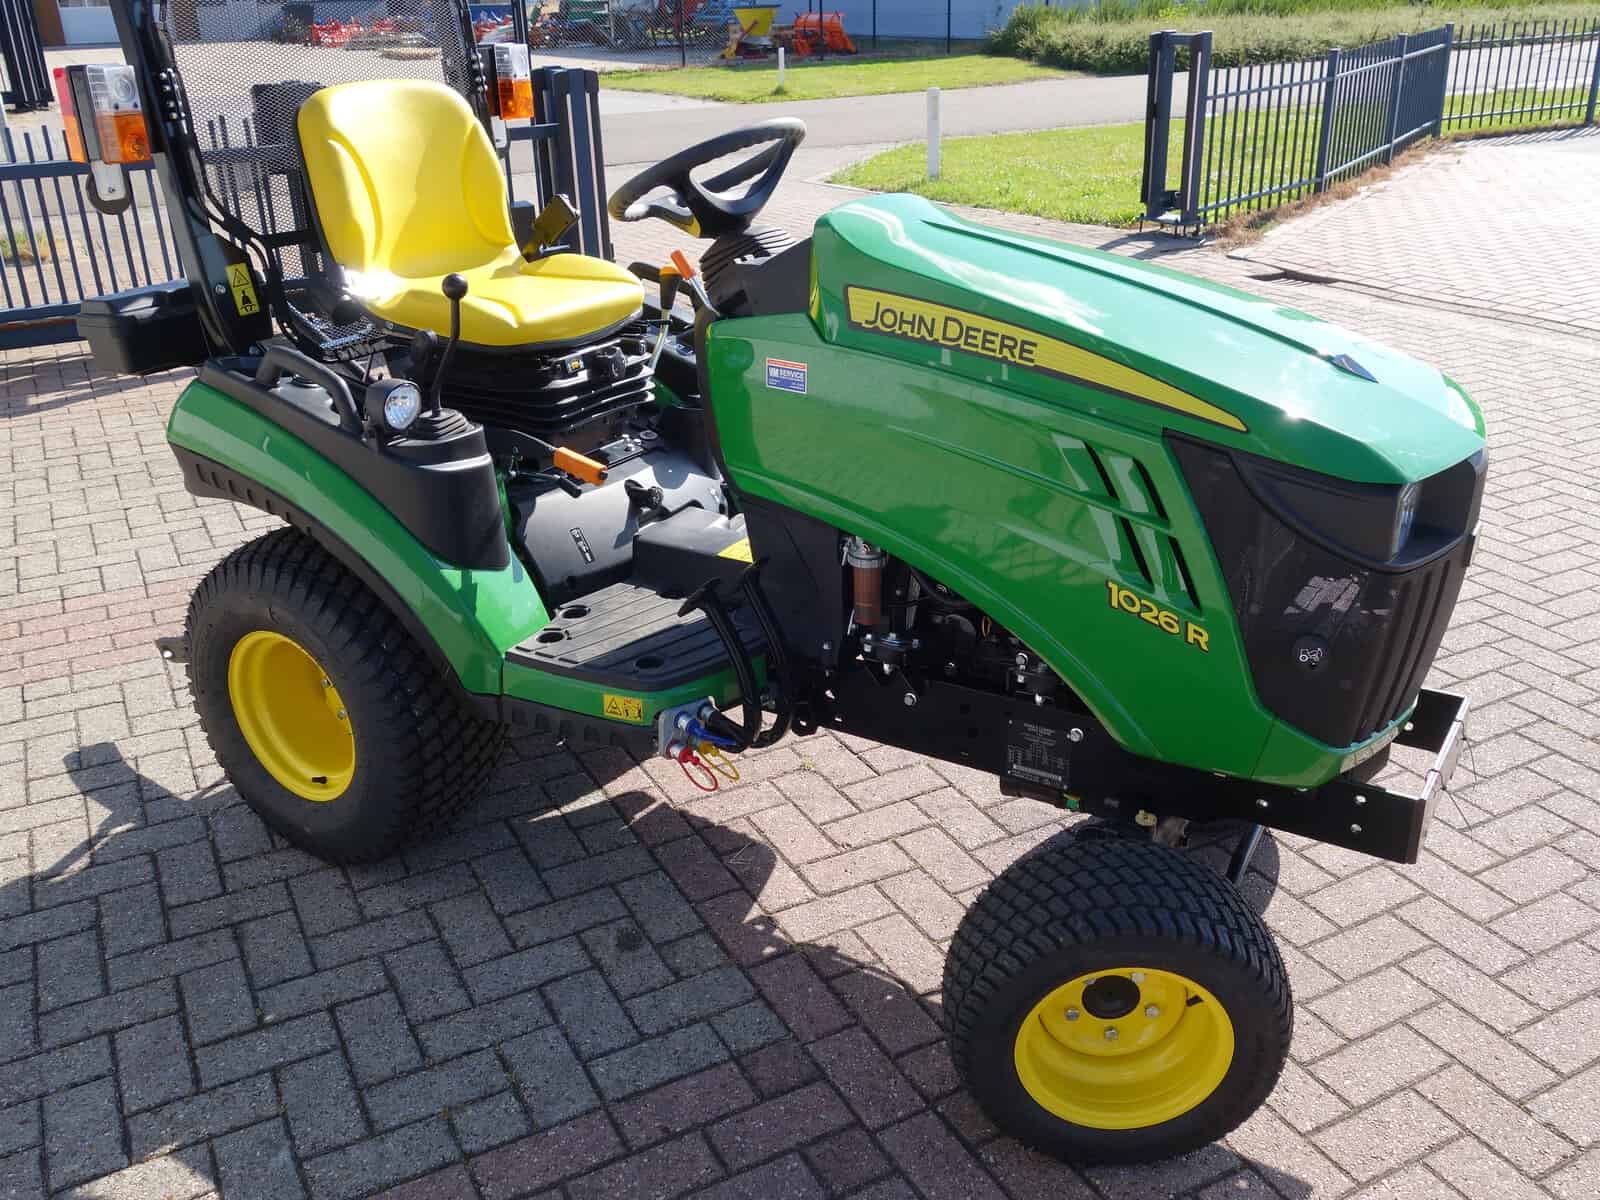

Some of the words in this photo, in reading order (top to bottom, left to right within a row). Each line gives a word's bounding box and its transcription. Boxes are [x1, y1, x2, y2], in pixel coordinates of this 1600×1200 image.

[865, 302, 936, 338] JOHN
[942, 316, 1038, 363] DEERE
[1107, 580, 1180, 635] 1026
[1185, 621, 1209, 653] R
